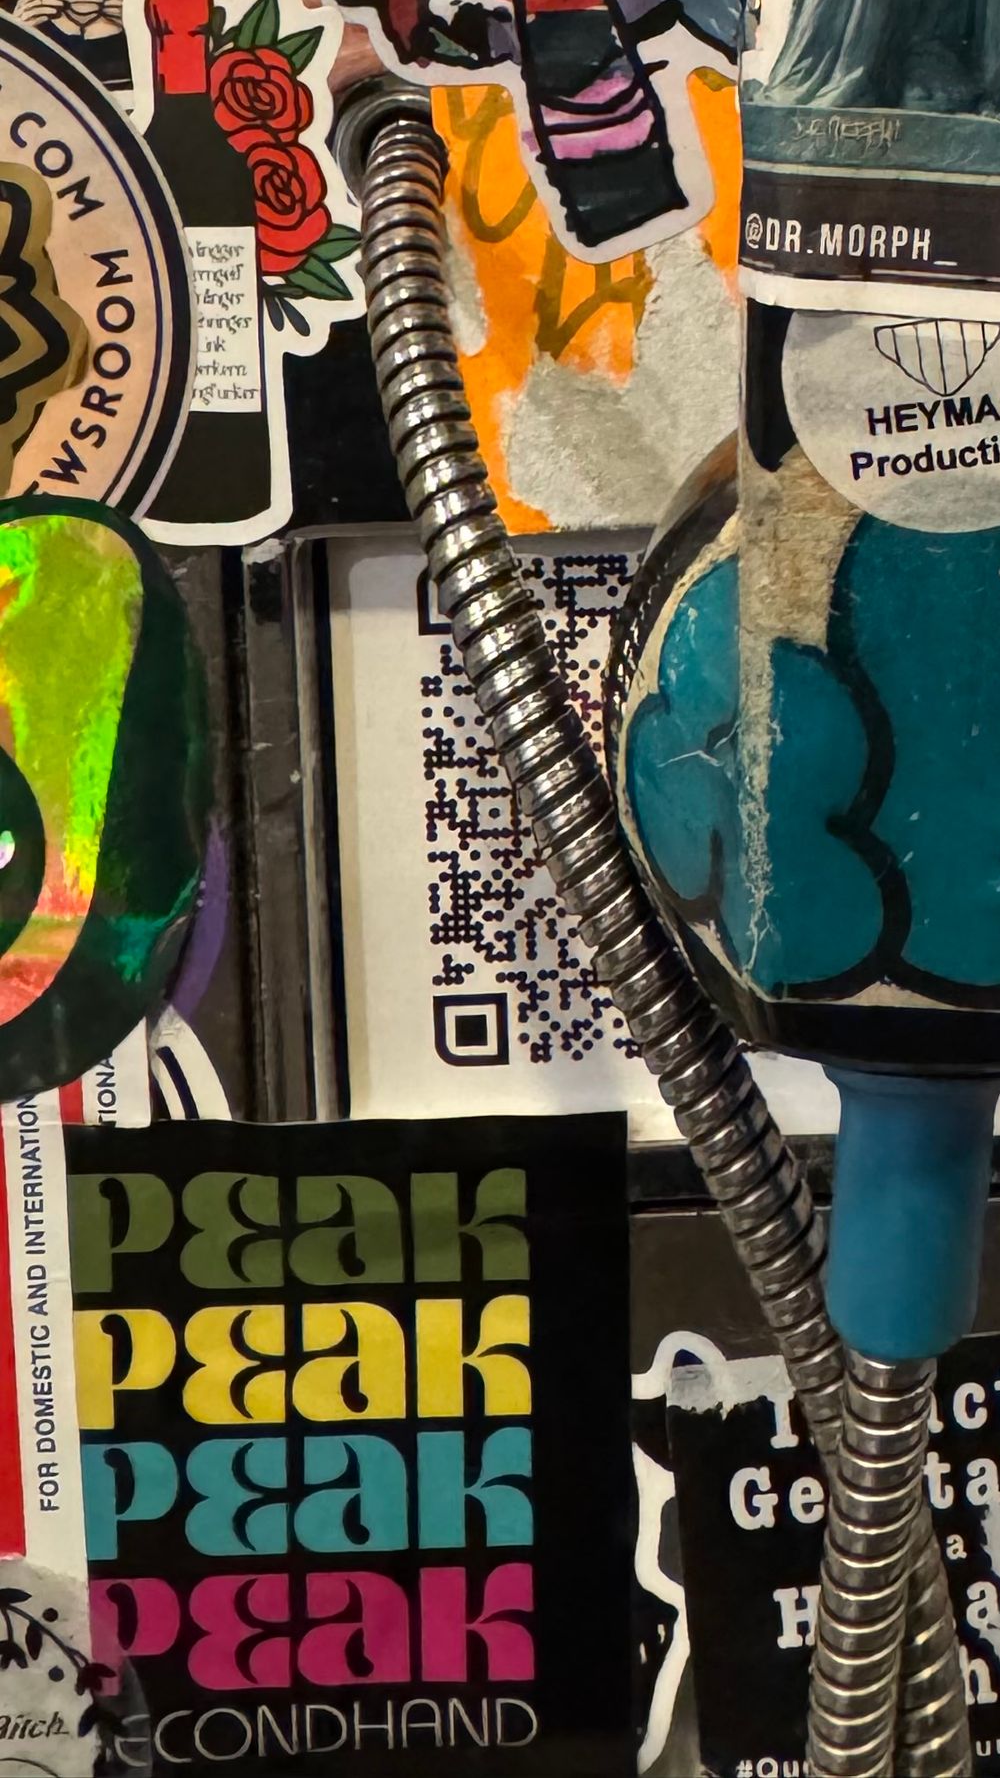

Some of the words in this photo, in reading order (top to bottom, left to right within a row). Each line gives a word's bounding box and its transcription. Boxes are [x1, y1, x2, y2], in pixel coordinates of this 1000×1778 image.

[25, 1263, 48, 1316] AND
[67, 1168, 531, 1293] PEAK
[31, 1324, 57, 1455] DOMESTIC
[73, 1295, 533, 1430] PEAK
[39, 1465, 61, 1512] FOR
[82, 1427, 535, 1562] PEAK
